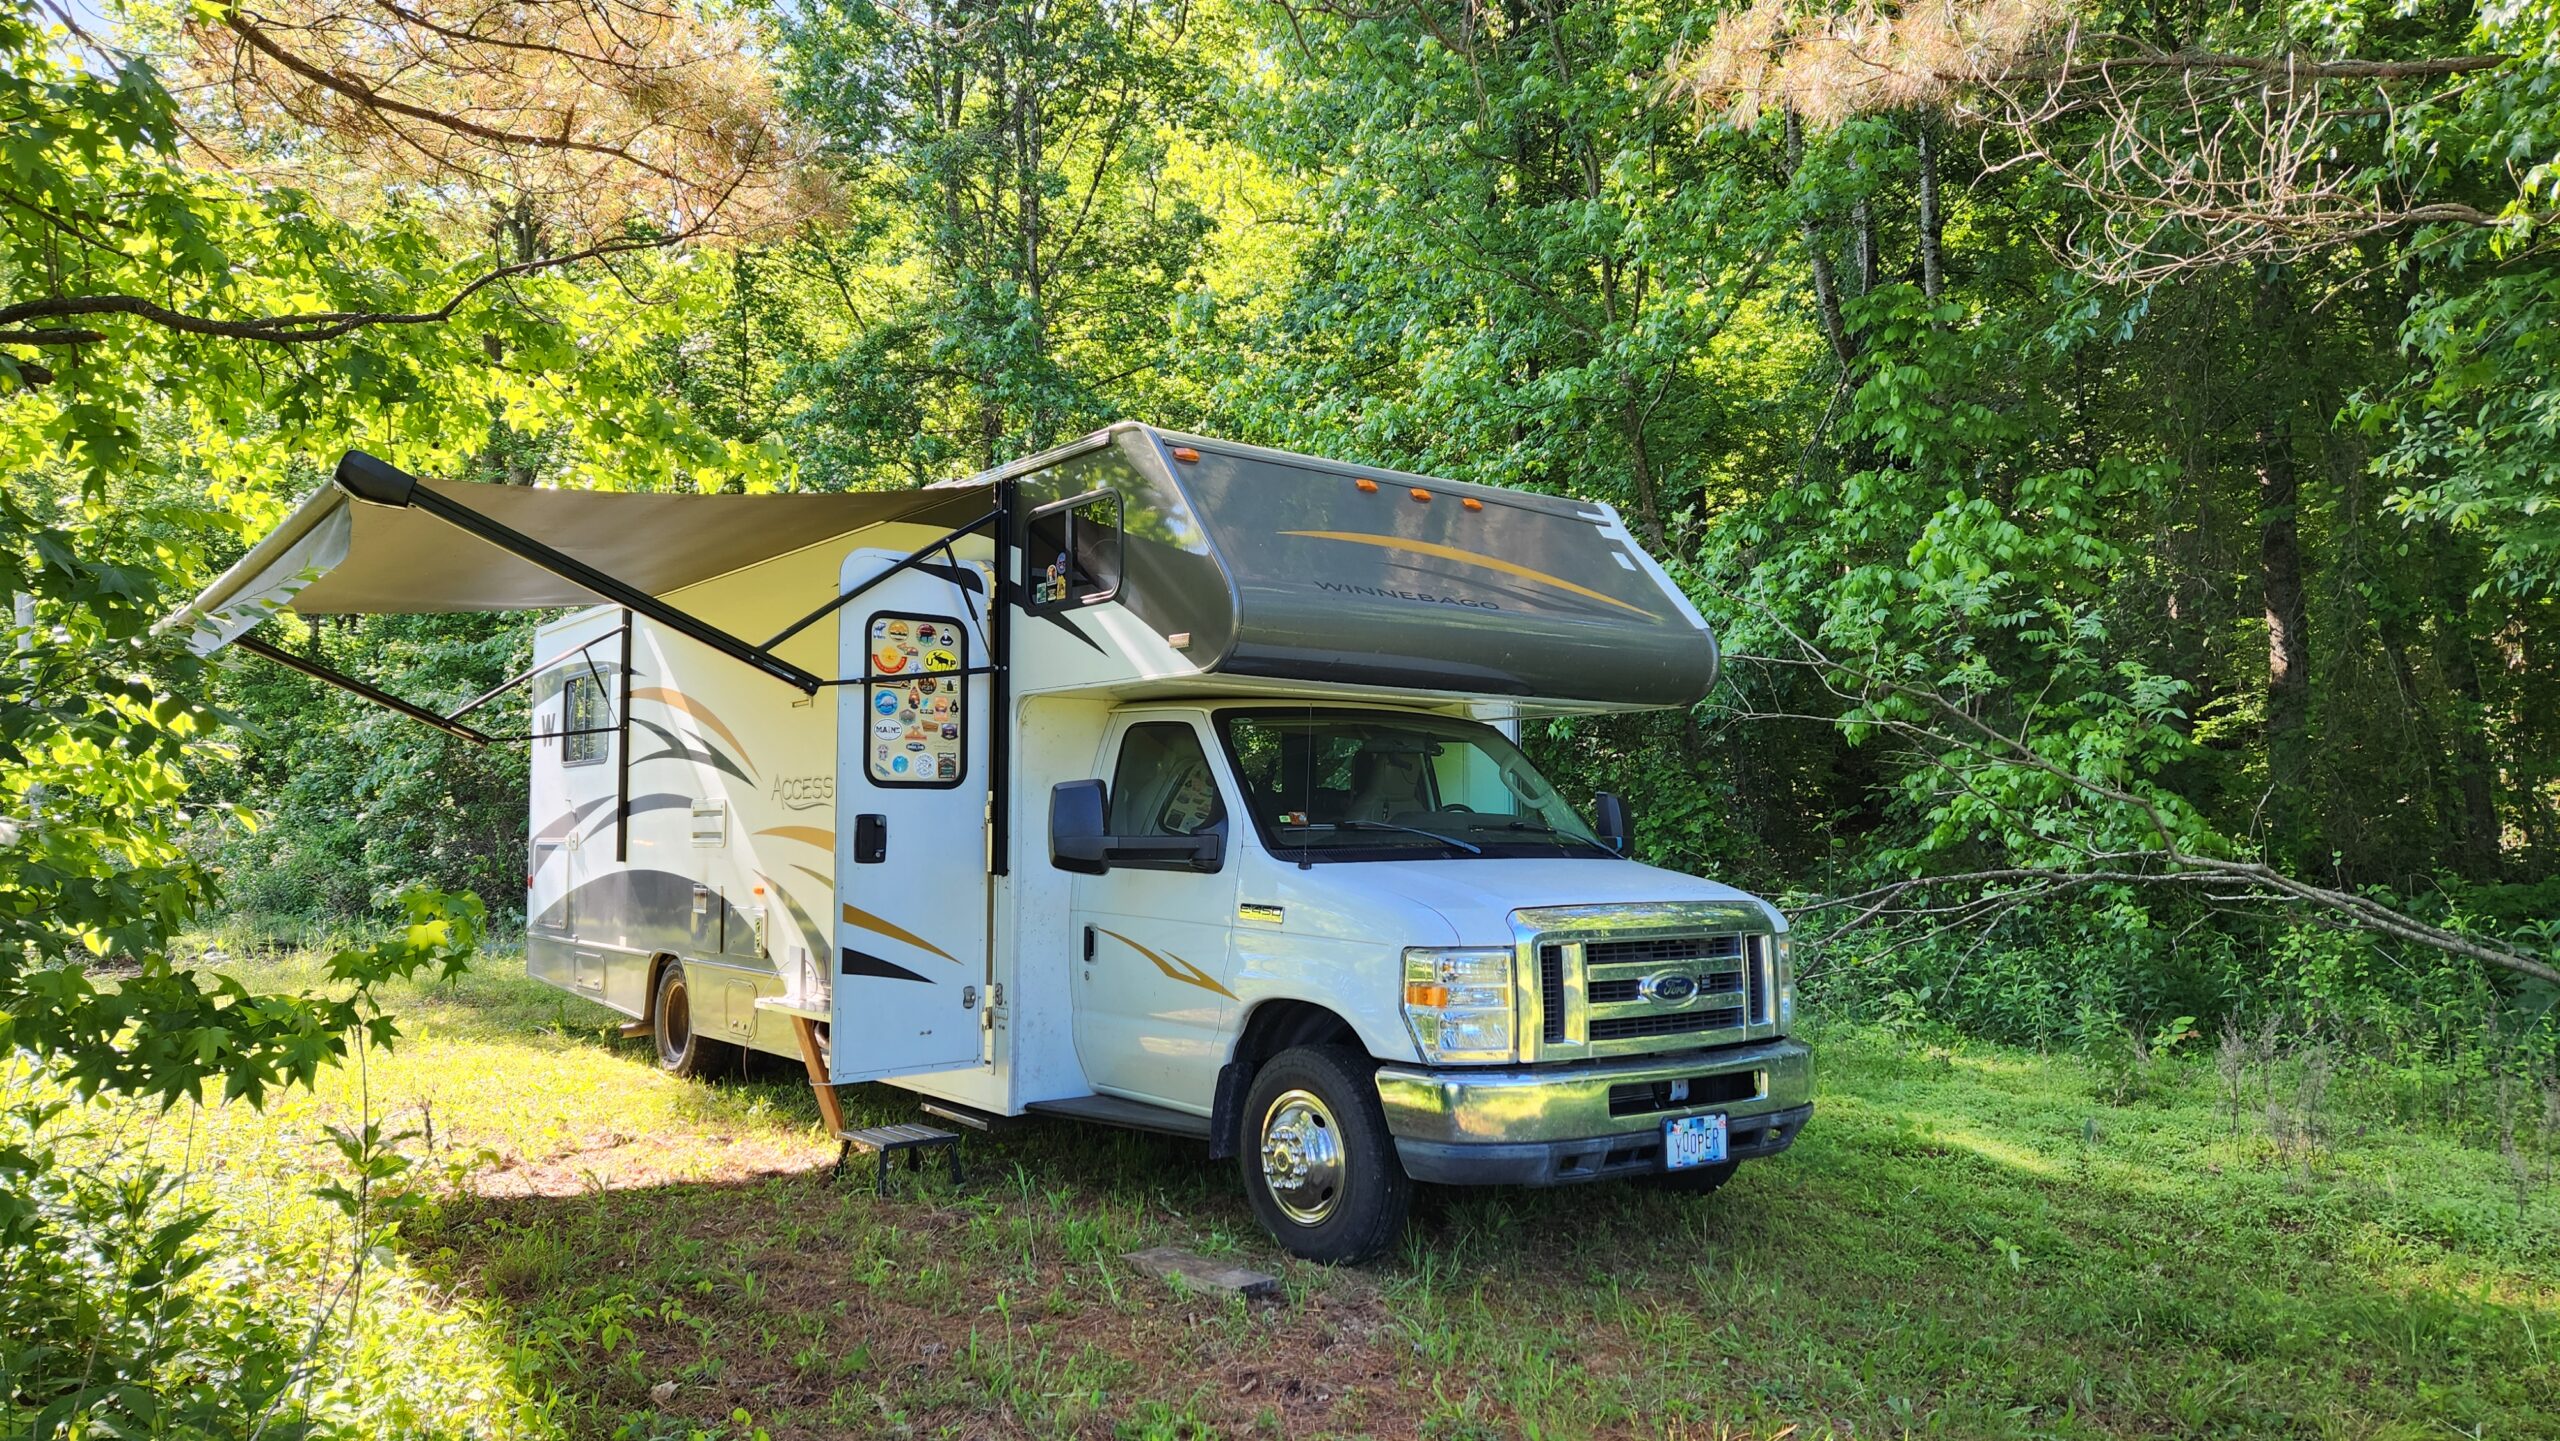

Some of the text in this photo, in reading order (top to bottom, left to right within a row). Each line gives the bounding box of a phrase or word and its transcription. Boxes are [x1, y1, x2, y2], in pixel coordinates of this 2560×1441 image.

[1313, 580, 1500, 610] WINNEBAGO
[925, 657, 957, 668] U P
[541, 712, 556, 747] W
[770, 773, 834, 810] ACCESS
[1663, 979, 1688, 995] Ford
[1675, 1127, 1720, 1159] YOOPER
